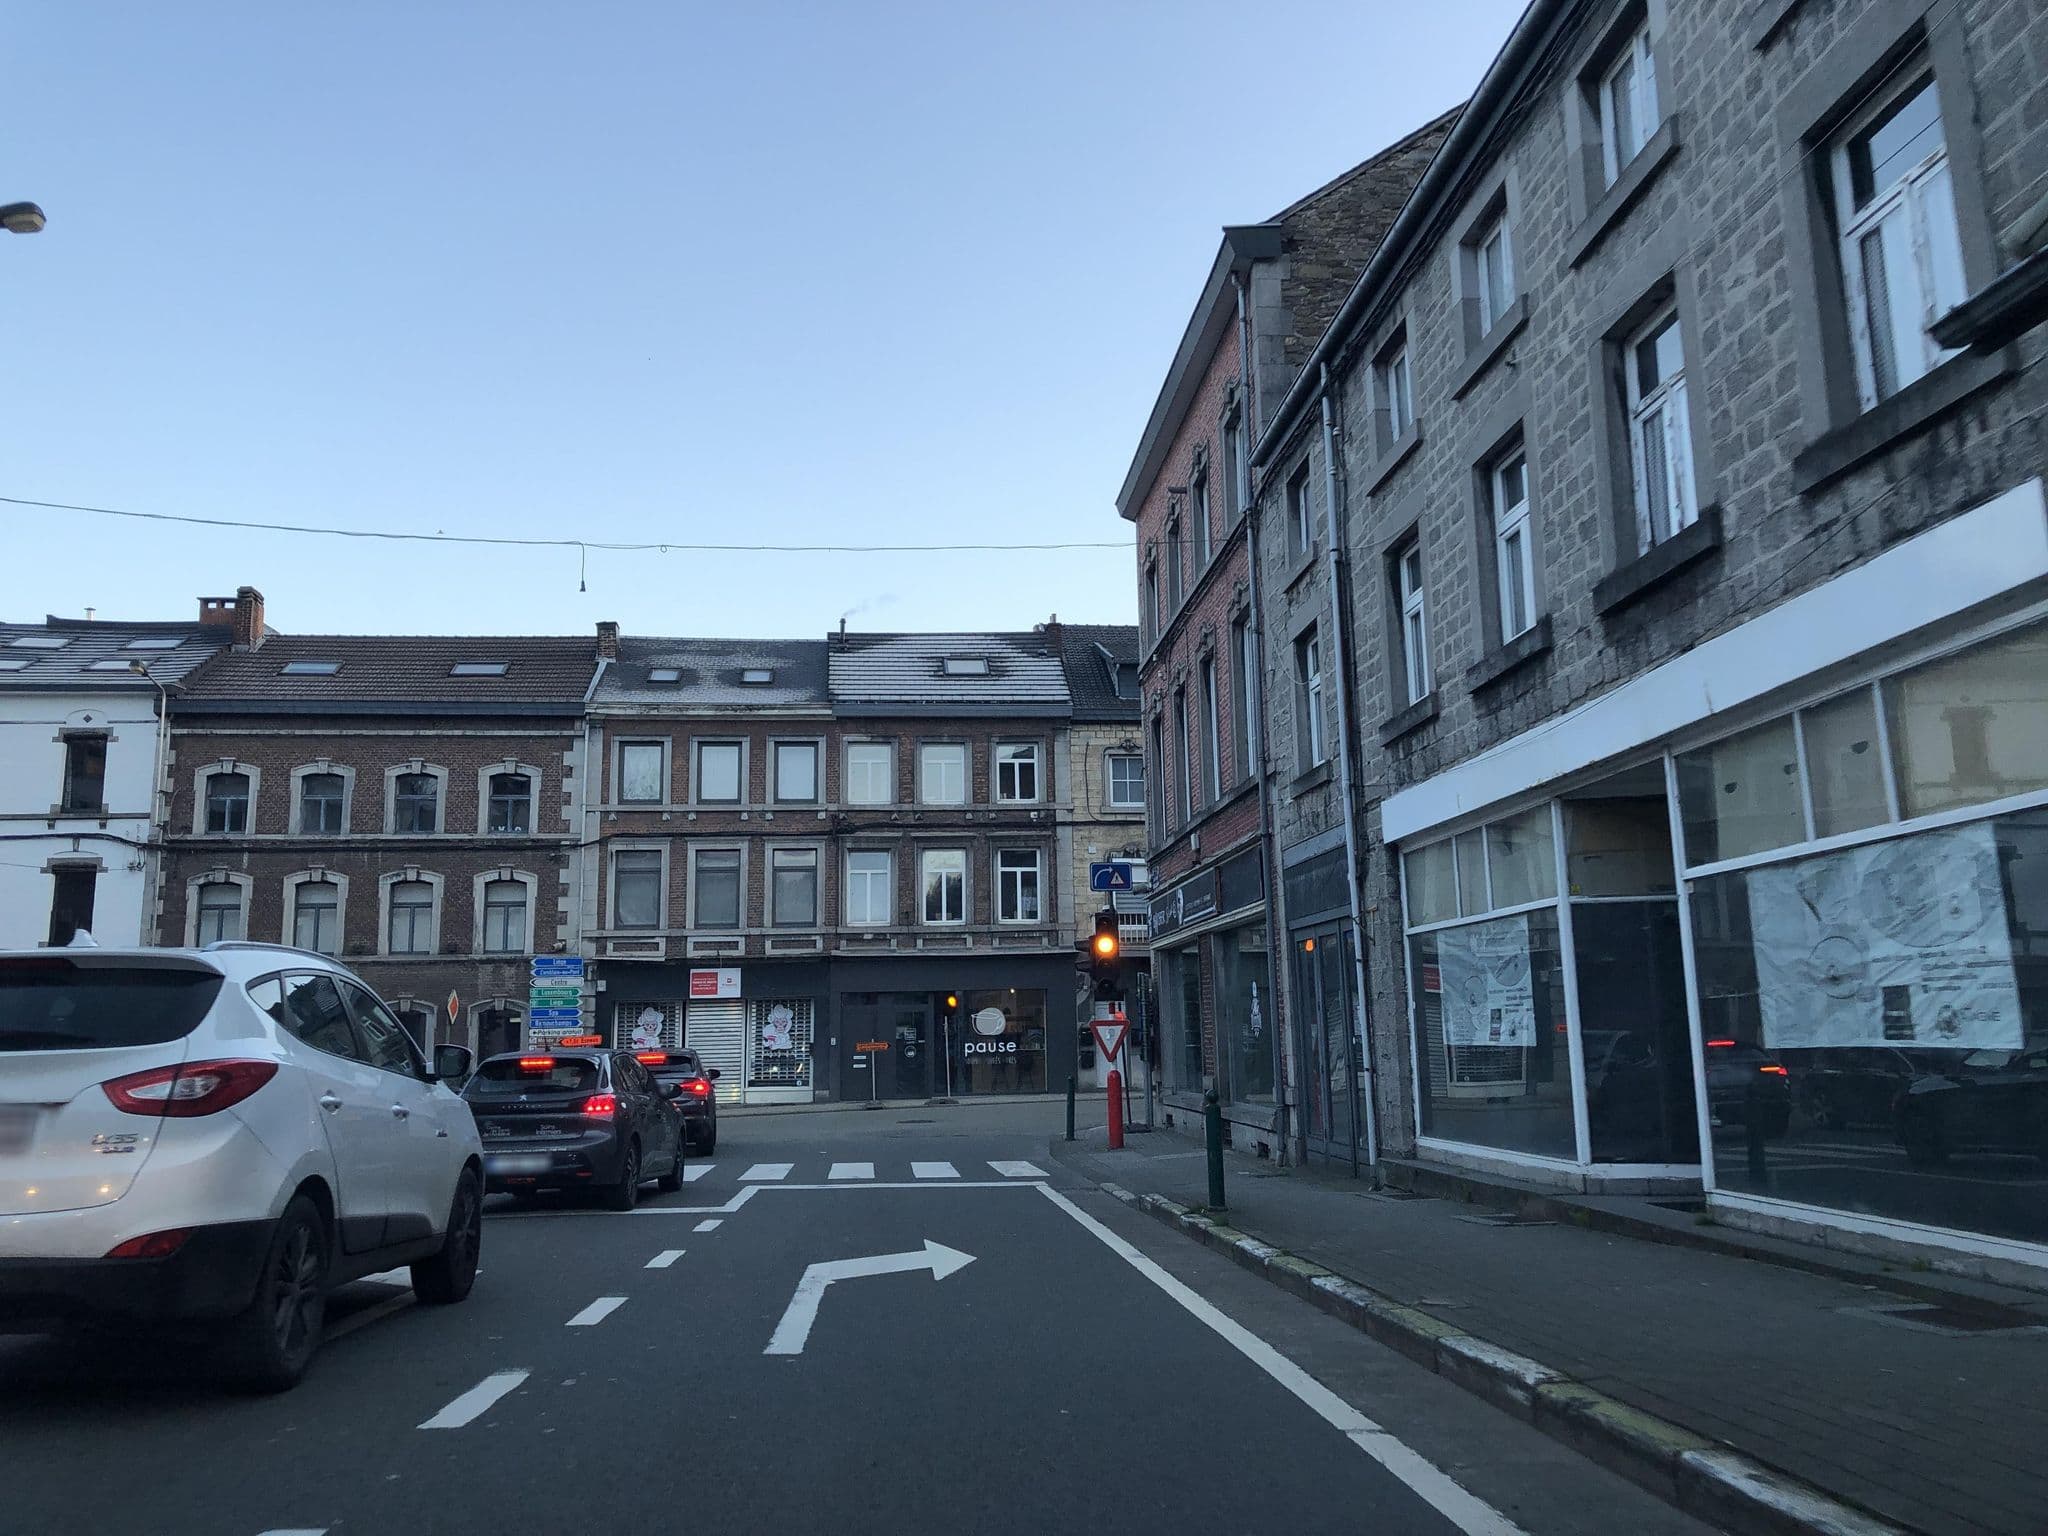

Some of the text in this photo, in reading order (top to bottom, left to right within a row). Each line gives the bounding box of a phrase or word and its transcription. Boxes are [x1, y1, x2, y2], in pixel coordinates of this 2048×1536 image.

[541, 988, 573, 997] Luxembourg
[548, 1009, 559, 1017] Spa
[964, 1041, 1017, 1057] pause
